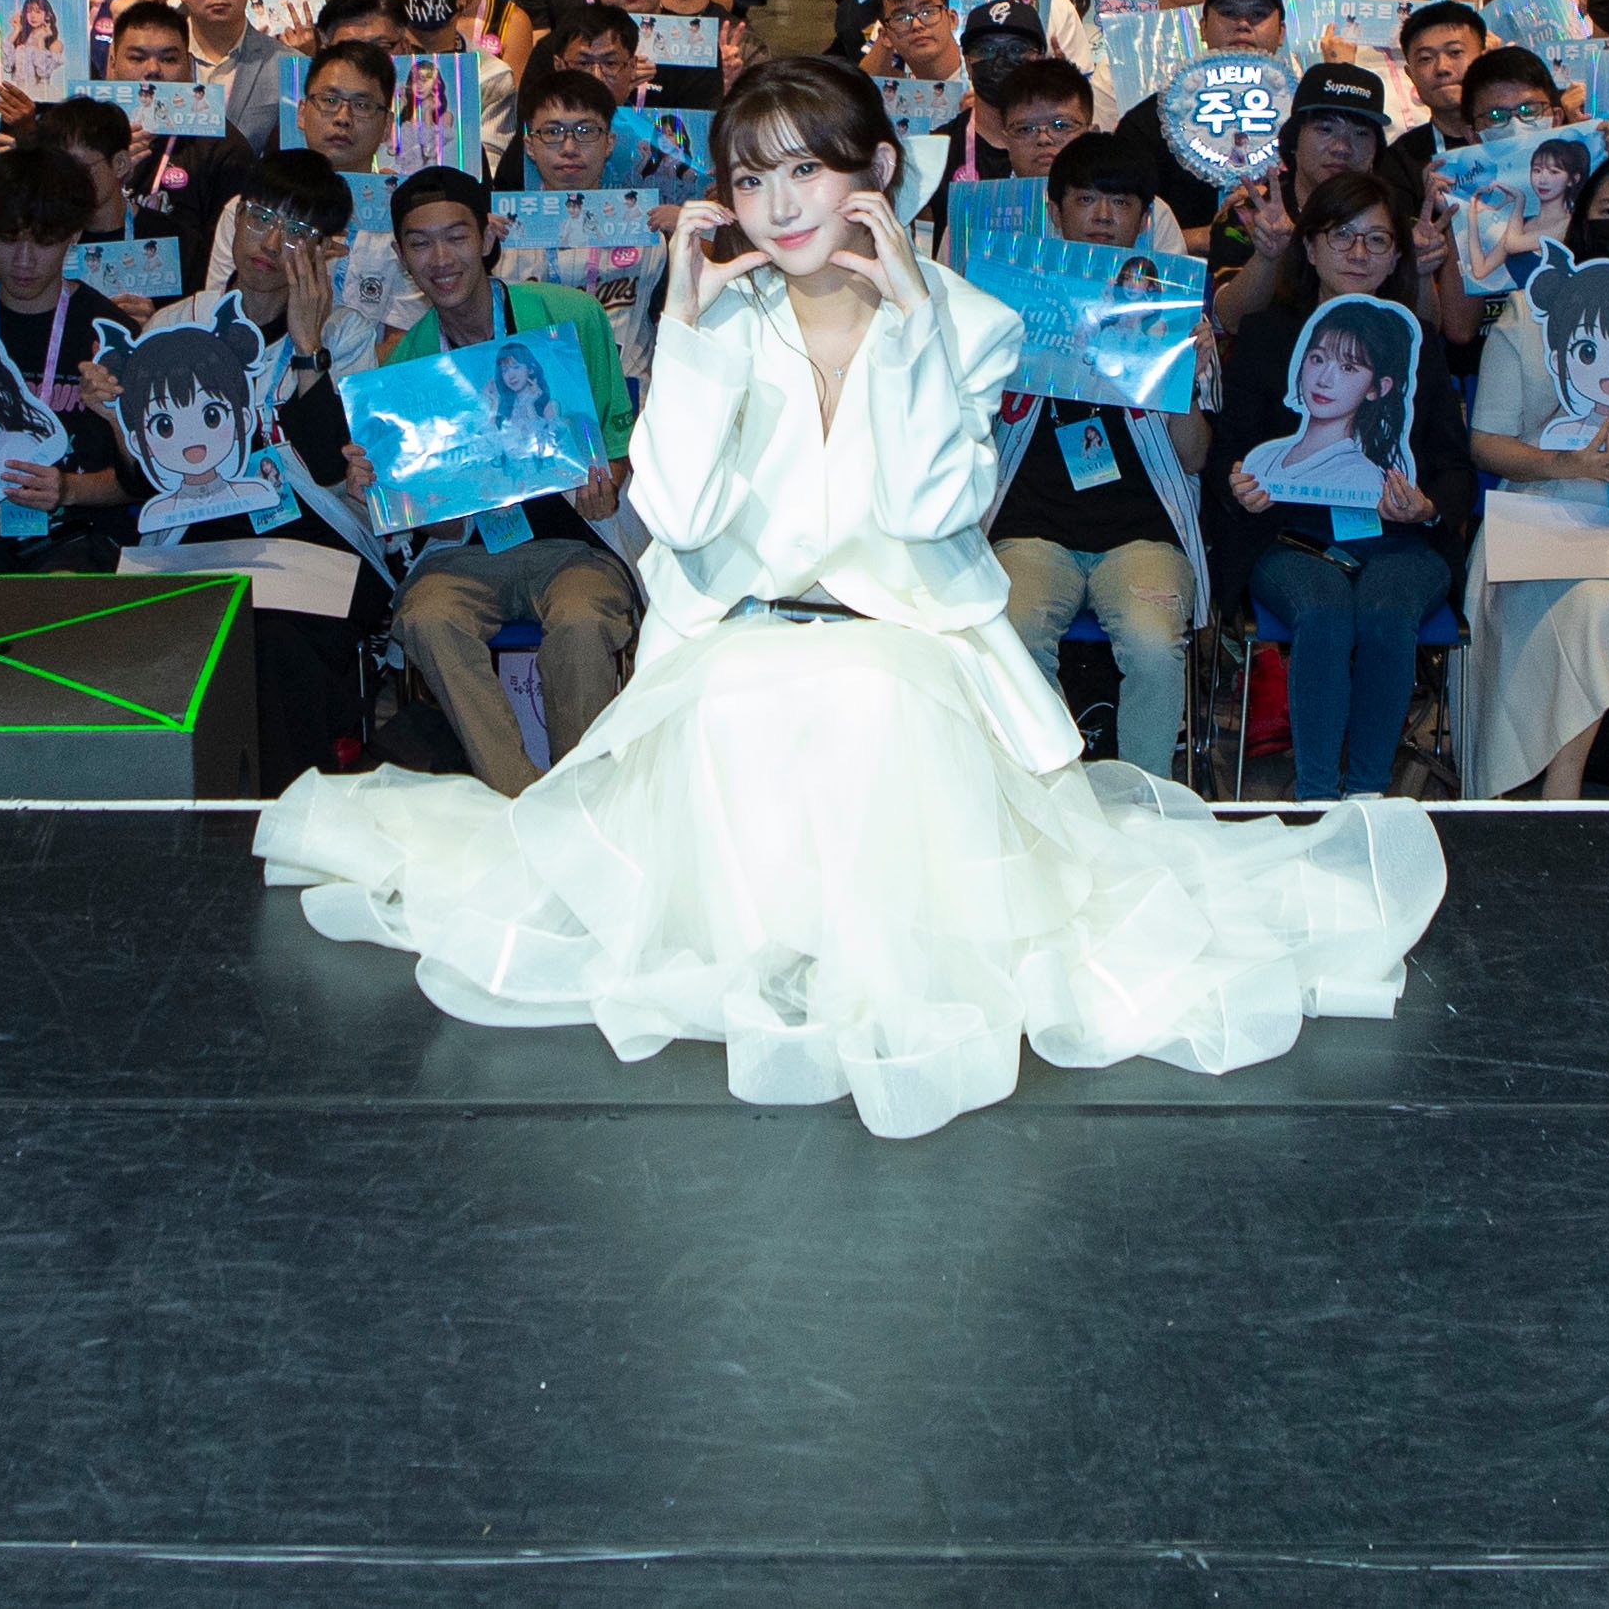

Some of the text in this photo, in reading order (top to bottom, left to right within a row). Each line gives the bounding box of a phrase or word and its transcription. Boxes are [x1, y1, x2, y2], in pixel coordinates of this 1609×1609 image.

[1206, 66, 1262, 85] JUEUN
[1324, 80, 1371, 98] Supreme
[1197, 92, 1277, 132] 주은
[1189, 137, 1227, 167] HAPPY
